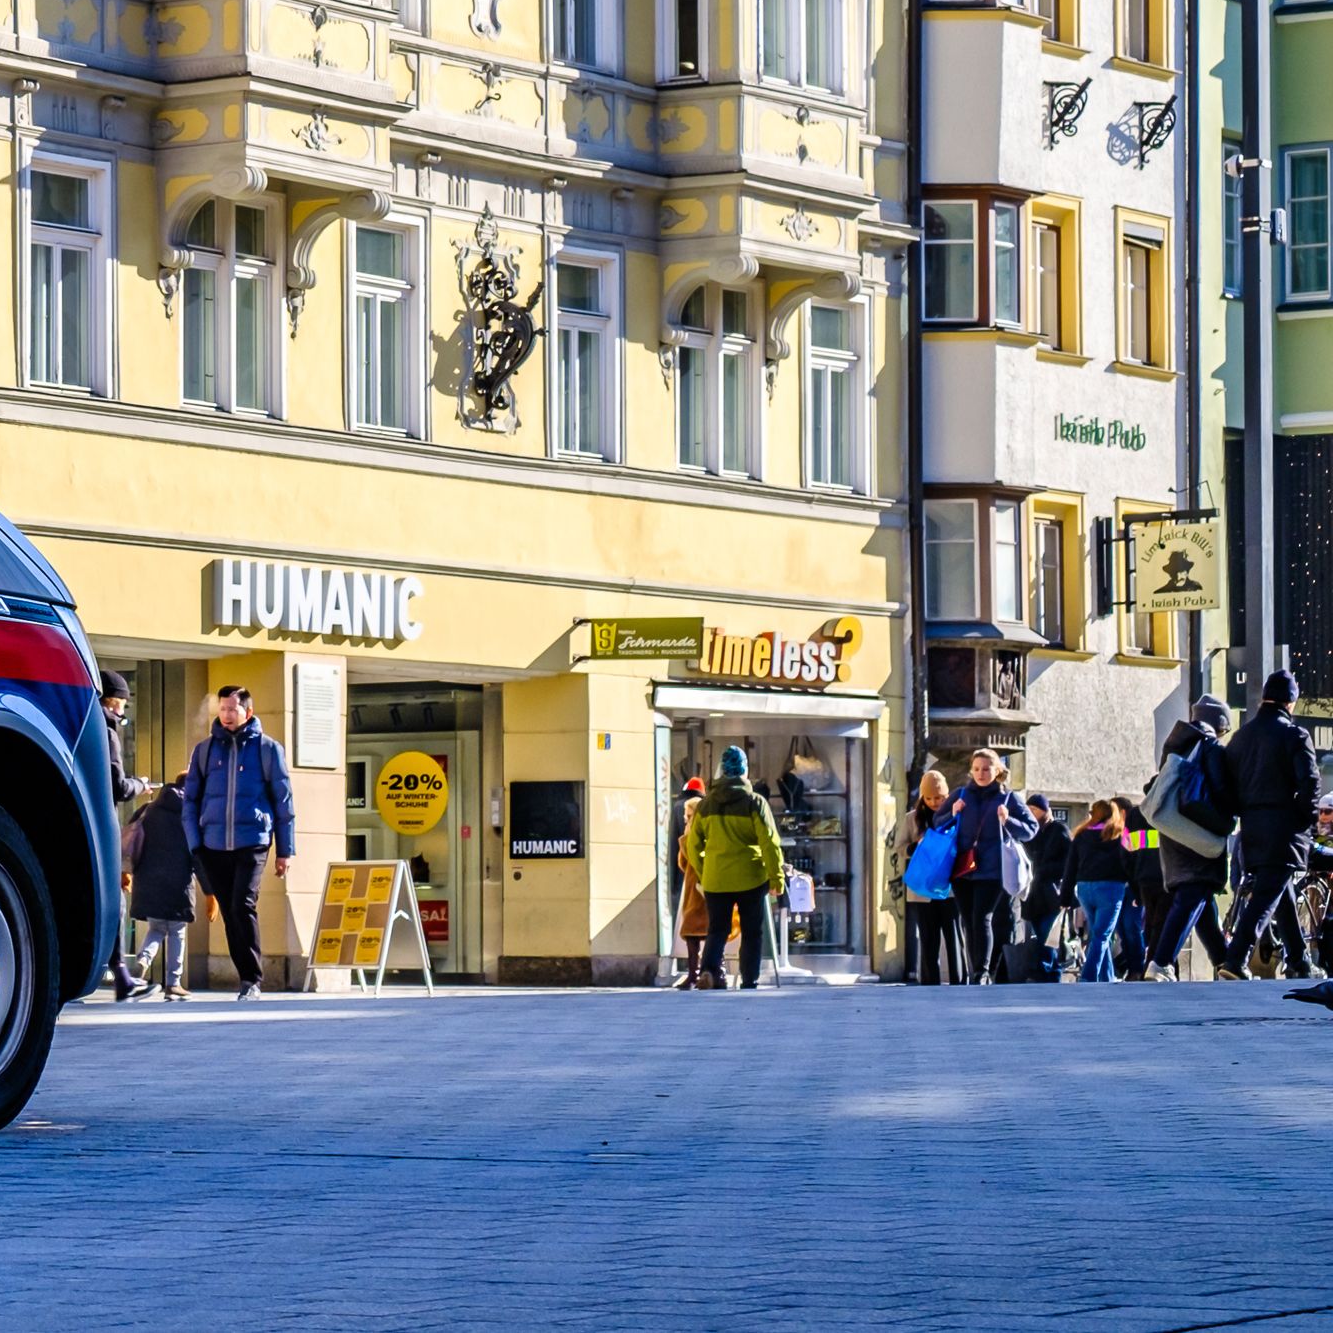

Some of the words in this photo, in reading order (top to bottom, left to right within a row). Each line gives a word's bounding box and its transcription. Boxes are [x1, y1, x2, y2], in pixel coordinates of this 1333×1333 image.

[218, 559, 423, 641] HUMANIC
[1151, 598, 1181, 608] Irish
[1184, 595, 1207, 606] Pub
[618, 636, 697, 649] Schmarda
[381, 774, 443, 791] -20%
[347, 798, 364, 806] ANIC
[513, 840, 577, 854] HUMANIC
